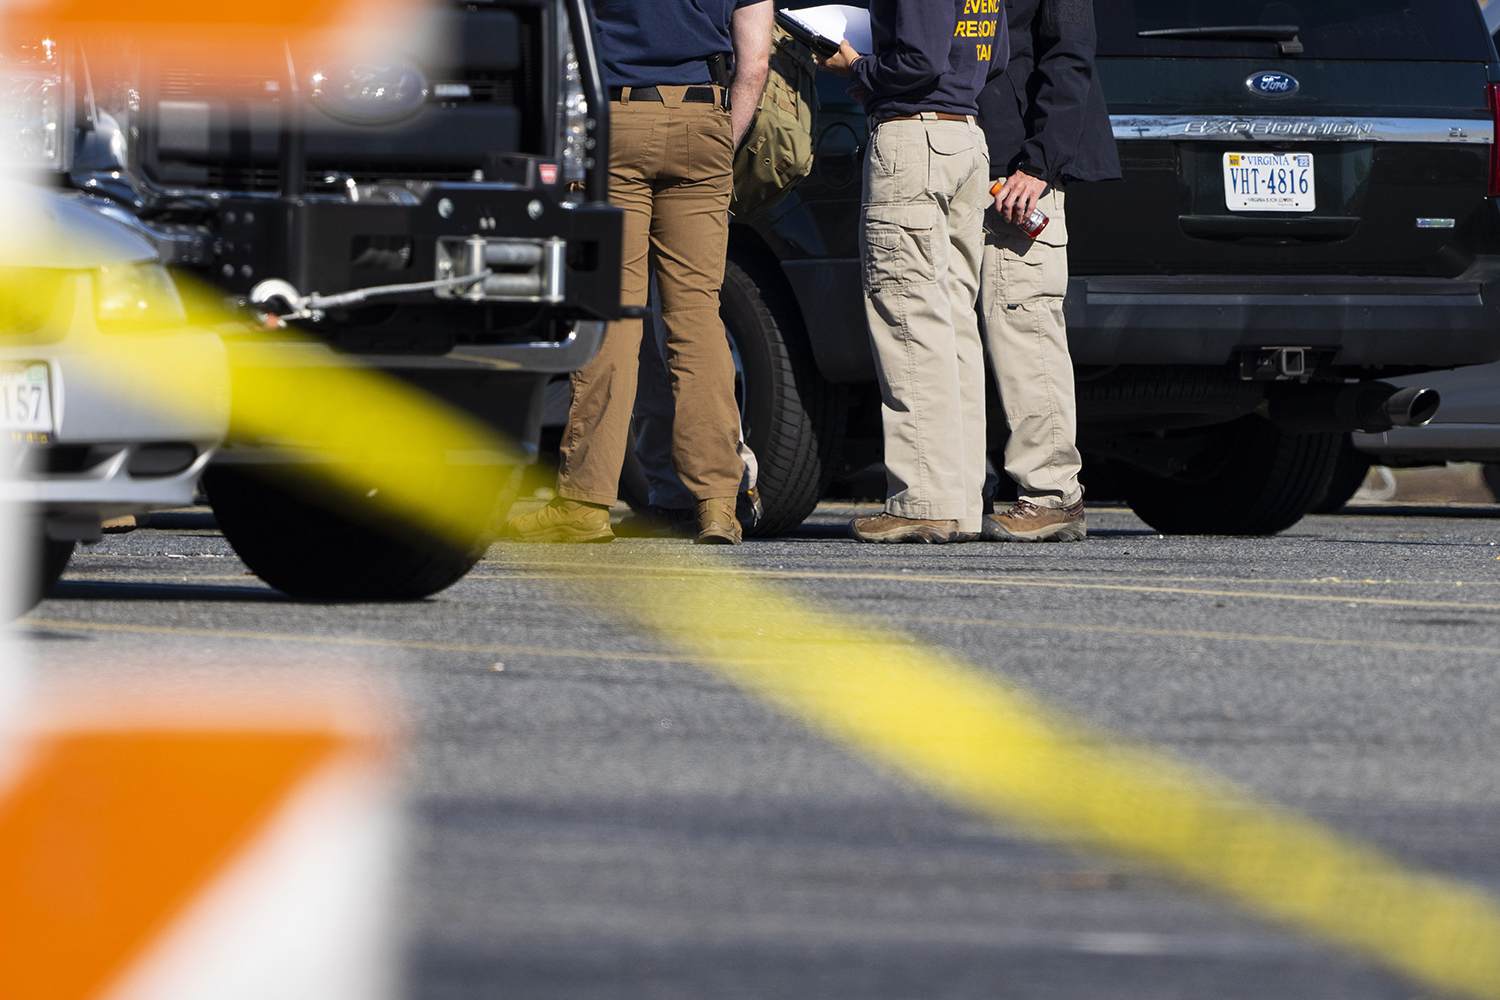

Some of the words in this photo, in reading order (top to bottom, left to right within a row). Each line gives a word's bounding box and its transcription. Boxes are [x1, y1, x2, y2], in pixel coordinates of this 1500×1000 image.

[1260, 74, 1290, 91] Ford
[1184, 120, 1373, 137] EXPEDITION
[1247, 156, 1290, 166] VIRGINIA
[1230, 168, 1309, 194] VHT-4816
